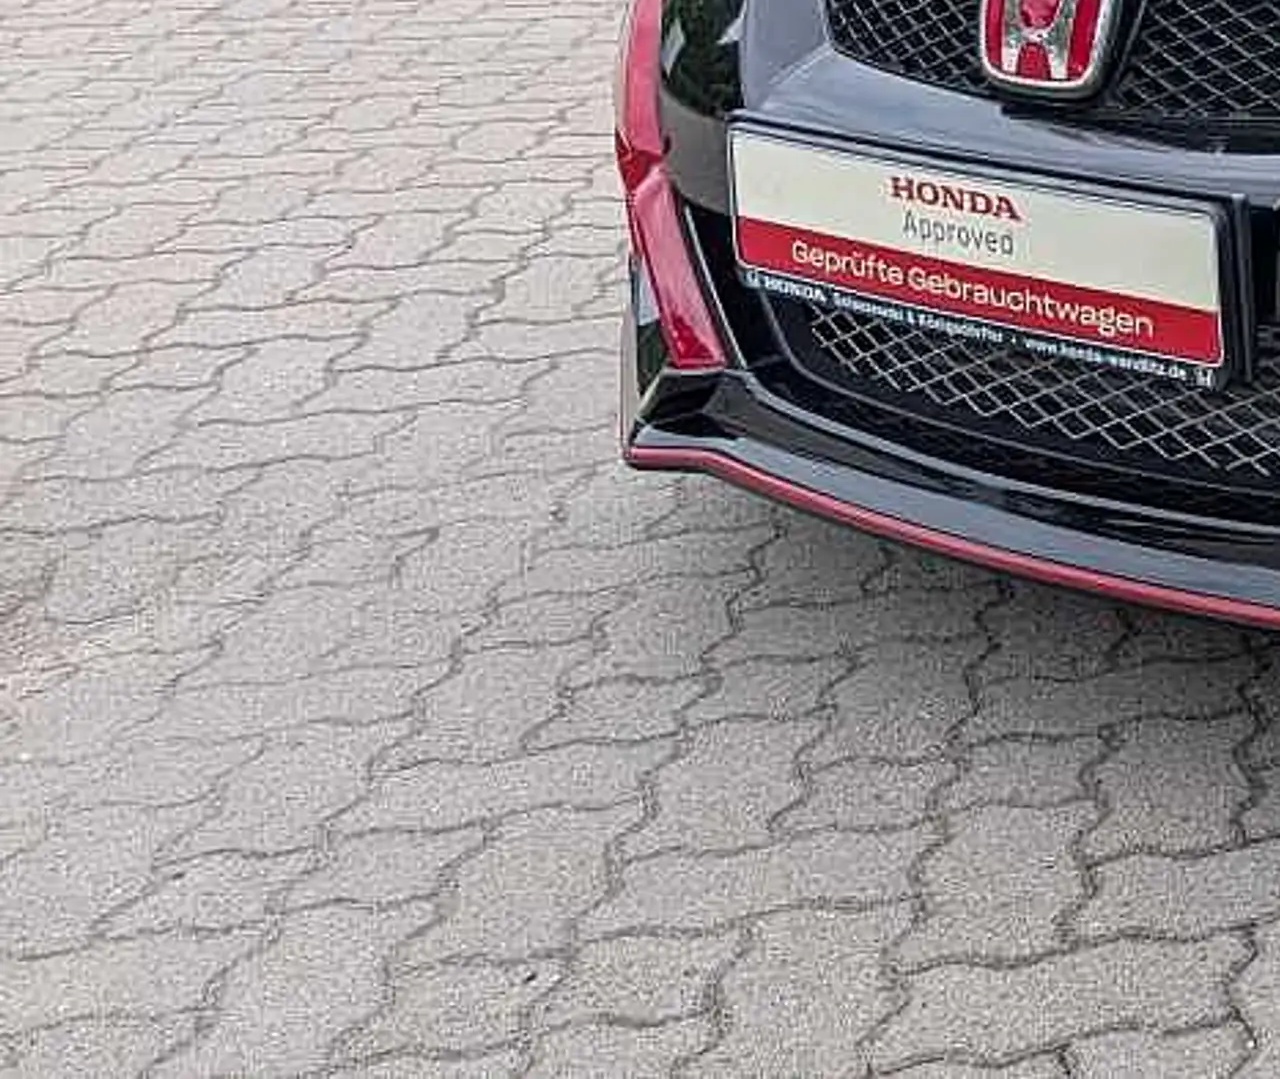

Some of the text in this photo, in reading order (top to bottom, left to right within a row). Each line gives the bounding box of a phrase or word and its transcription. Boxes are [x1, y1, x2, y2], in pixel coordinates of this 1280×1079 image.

[890, 176, 1022, 221] HONDA
[902, 209, 1014, 256] Approved
[764, 275, 827, 303] HONDA
[791, 240, 904, 285] Geprüfte
[906, 266, 1154, 339] Gebrauchtwagen
